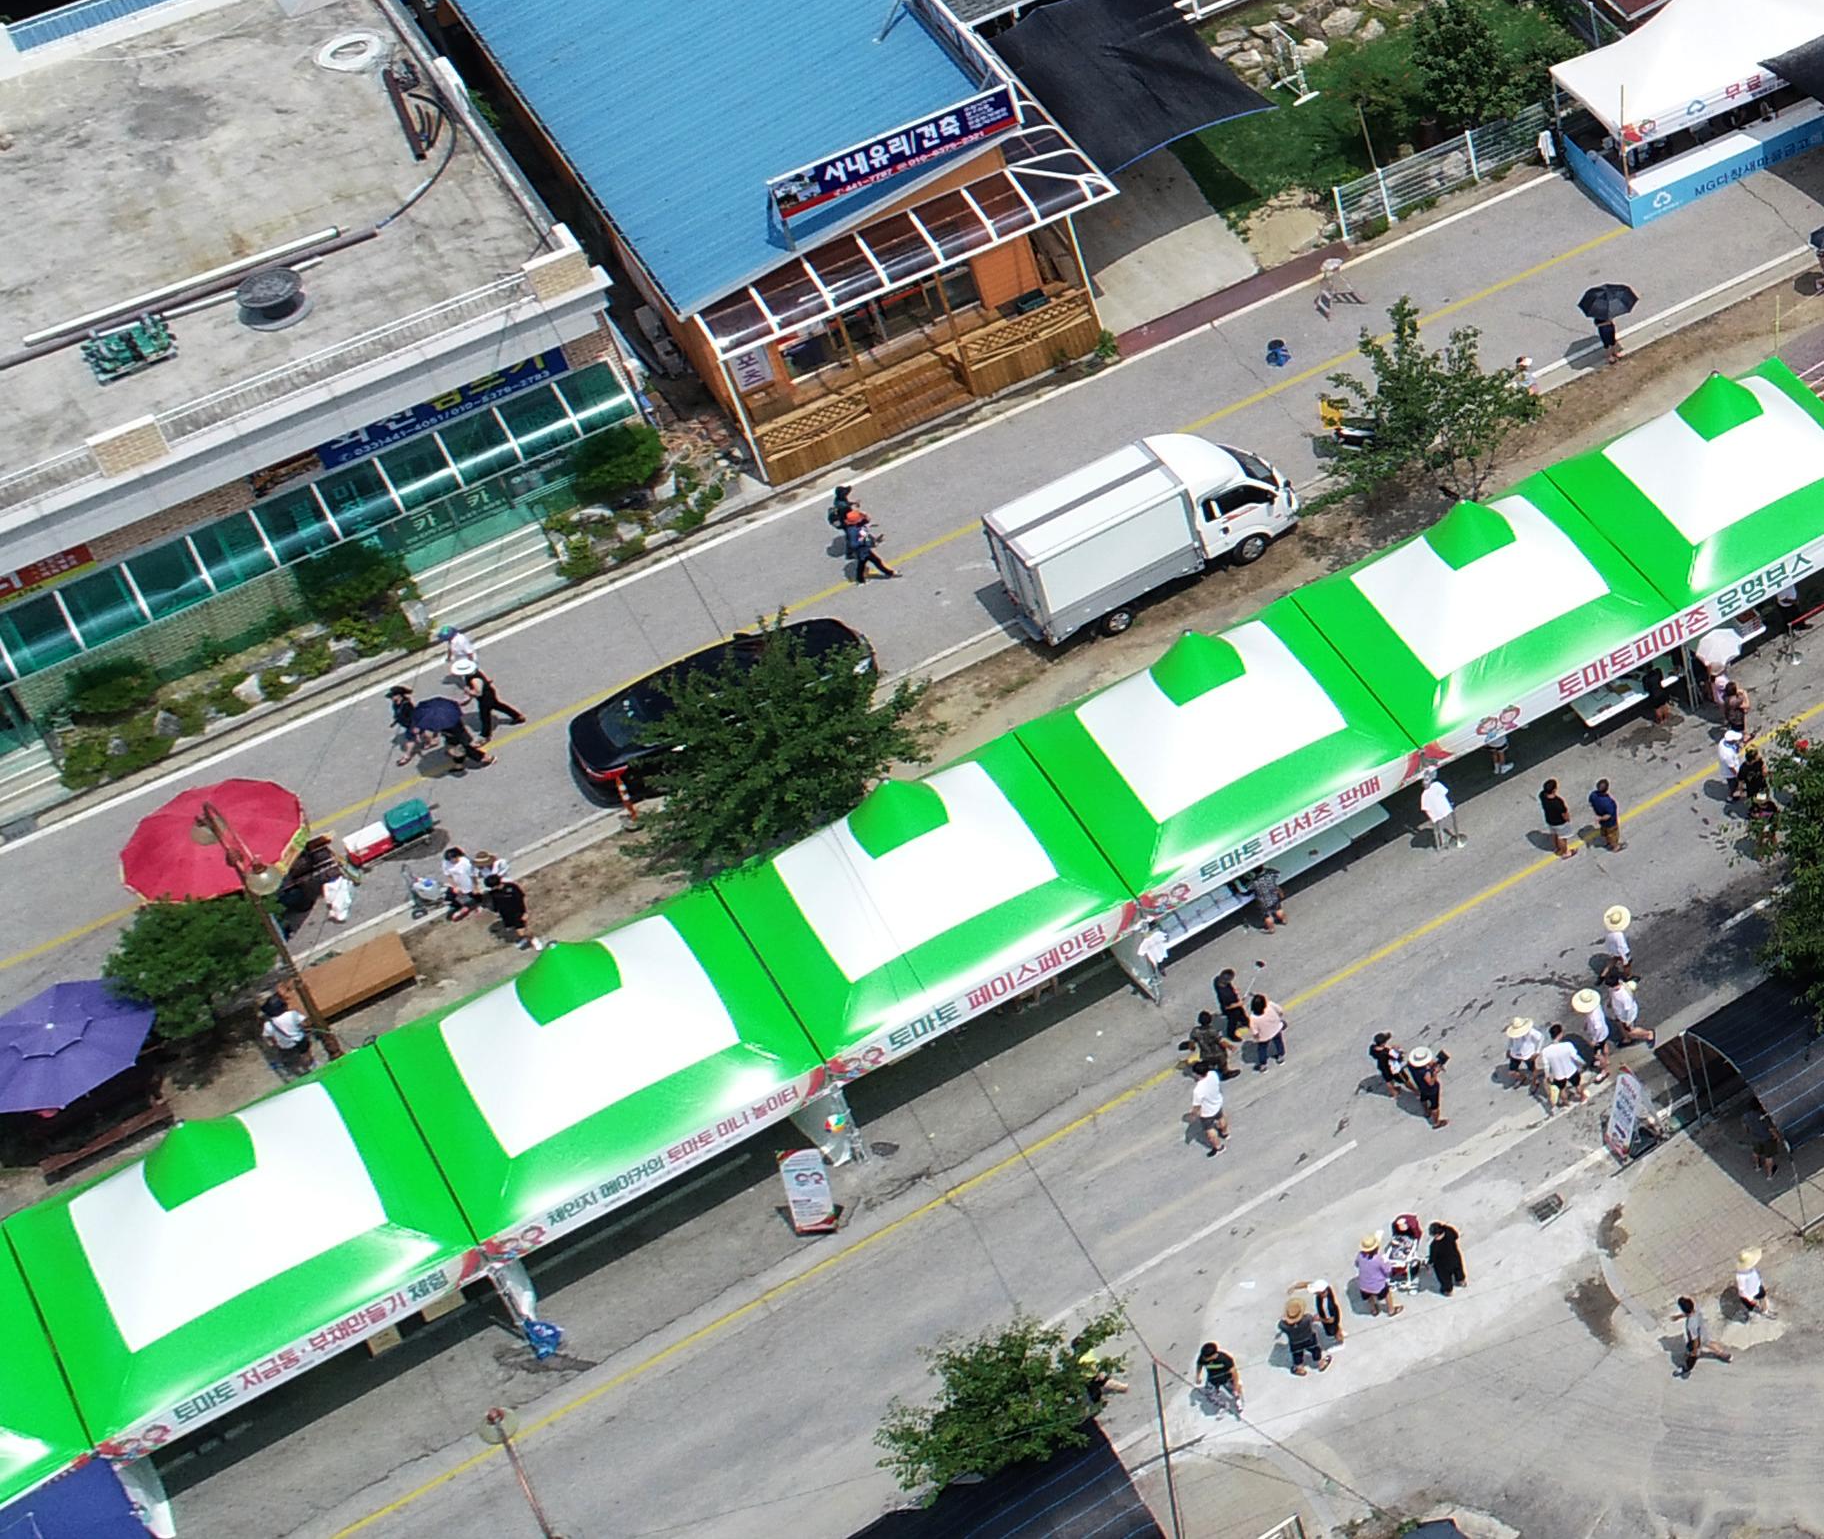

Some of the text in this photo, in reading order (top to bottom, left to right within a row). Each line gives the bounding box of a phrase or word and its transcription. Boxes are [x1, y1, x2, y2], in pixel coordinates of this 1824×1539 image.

[824, 114, 961, 182] 사내유리/건축
[1725, 74, 1762, 100] 무료
[1557, 553, 1815, 701] 토마토피아존 운영부스
[1199, 775, 1382, 884] 토마토 티셔츠 판매
[888, 924, 1108, 1053] 토마토 페이스페인팅
[547, 1085, 799, 1227] 체인지 메이커의 토마토 미니 놀이터
[173, 1381, 238, 1425] 토마토
[407, 1269, 449, 1302] 체험
